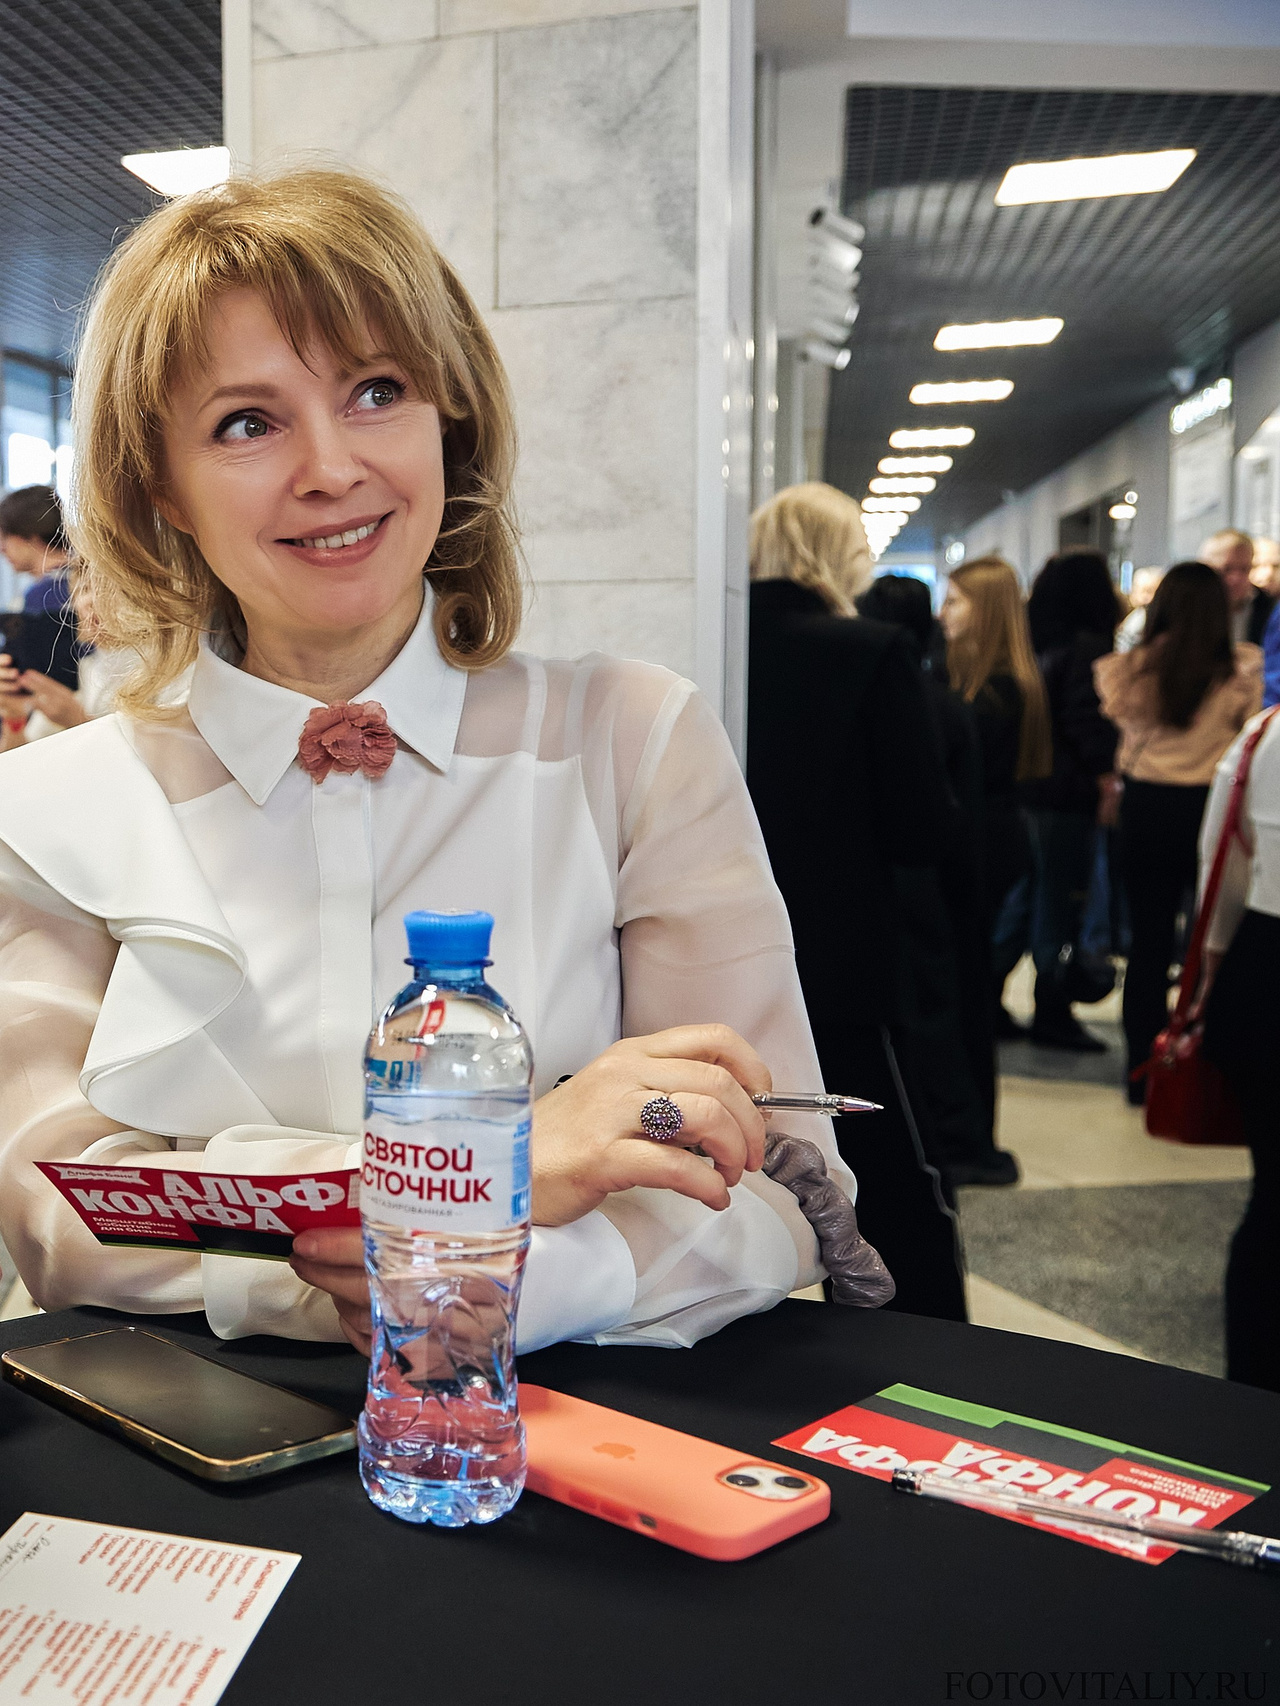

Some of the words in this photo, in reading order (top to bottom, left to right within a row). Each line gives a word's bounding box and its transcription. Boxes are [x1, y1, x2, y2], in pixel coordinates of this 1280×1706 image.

[364, 1131, 473, 1172] СВЯТОЙ
[363, 1161, 493, 1203] СТОЧНИК
[69, 1188, 296, 1235] КОНФА
